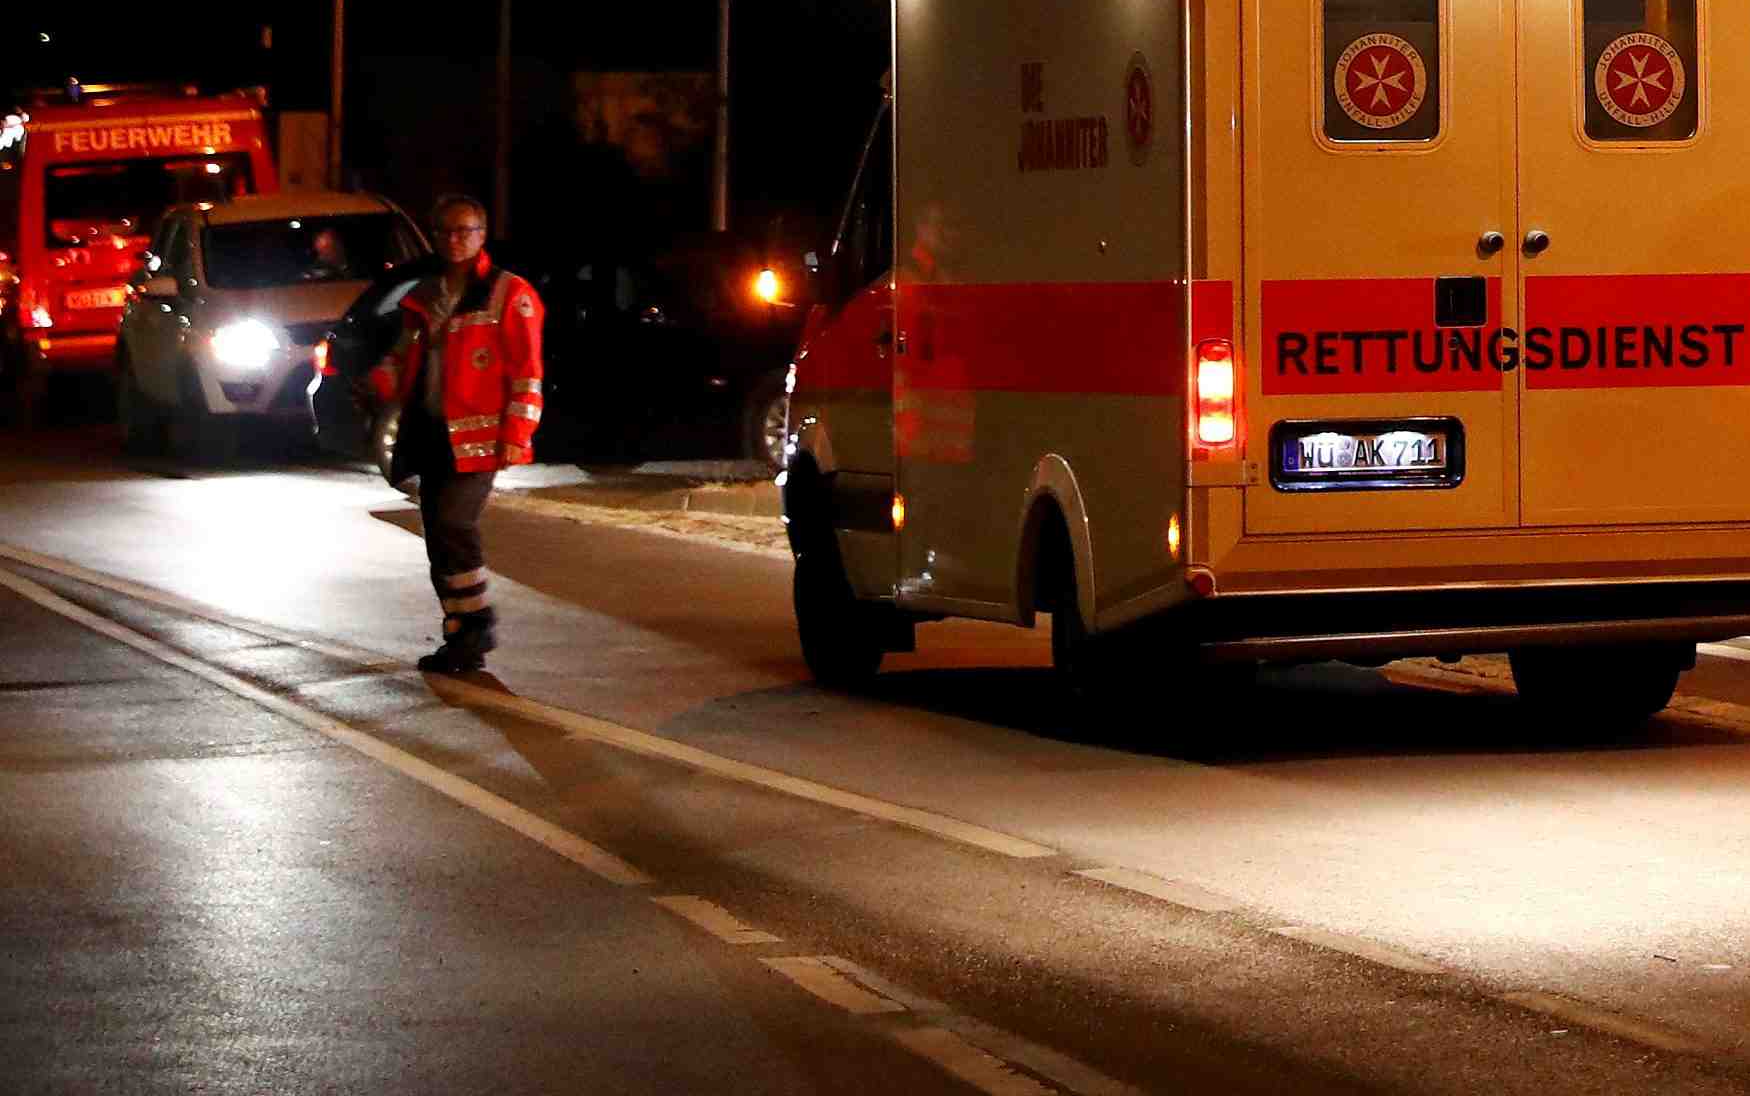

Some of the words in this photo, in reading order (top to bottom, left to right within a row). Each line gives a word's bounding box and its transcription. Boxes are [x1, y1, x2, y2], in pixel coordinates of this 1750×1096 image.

[1600, 34, 1677, 70] JOHANNITER
[54, 122, 233, 153] FEUERWEHR
[1276, 323, 1745, 376] RETTUNGSDIENST
[1353, 439, 1385, 466] AK
[1393, 439, 1443, 465] 711
